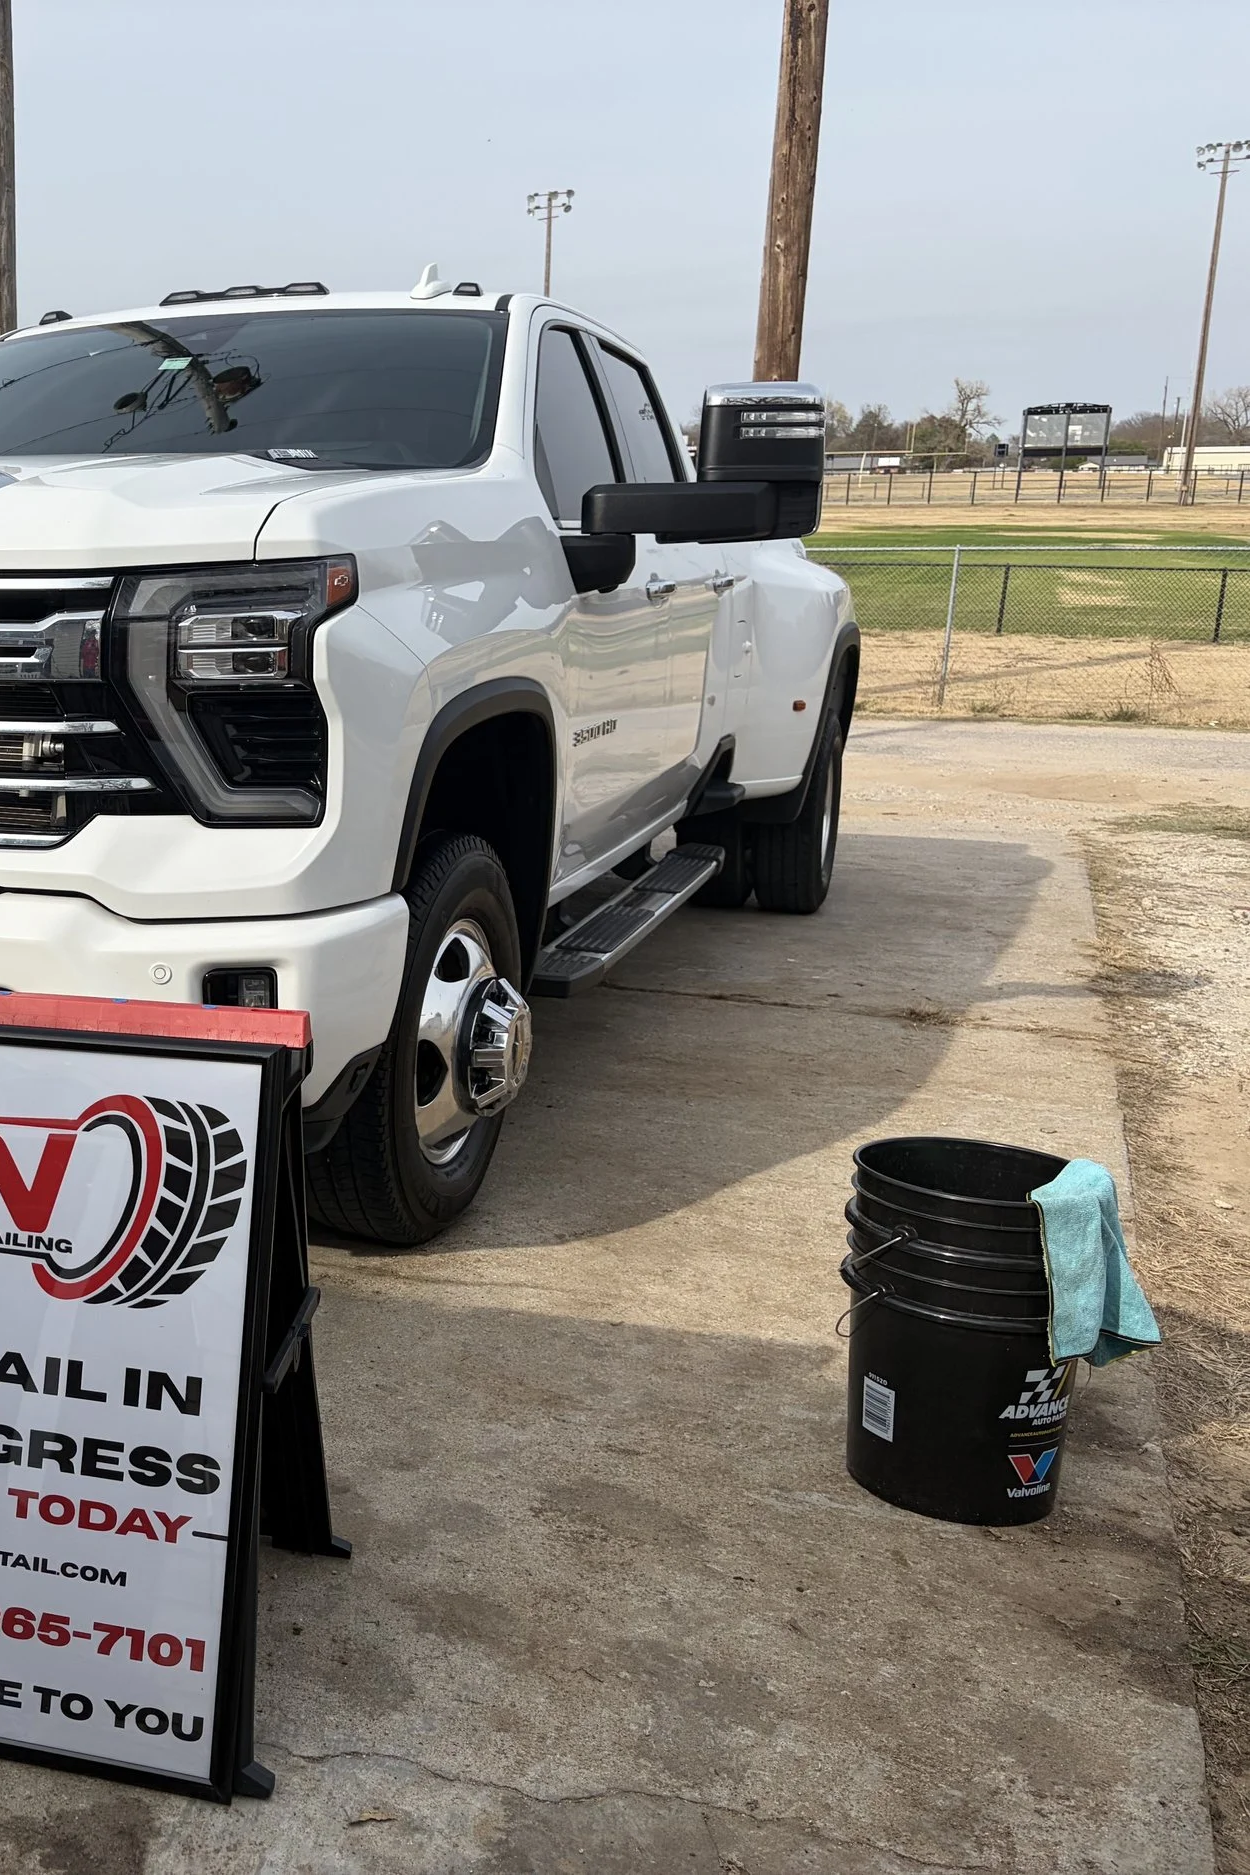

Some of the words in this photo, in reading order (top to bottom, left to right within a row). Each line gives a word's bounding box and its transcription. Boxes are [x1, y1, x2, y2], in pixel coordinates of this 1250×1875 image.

[123, 1367, 203, 1417] IN
[1031, 1416, 1052, 1426] AUTO
[1006, 1482, 1052, 1498] Valvoline
[7, 1487, 193, 1544] TODAY
[32, 1684, 94, 1722] TO
[103, 1698, 205, 1743] YOU
